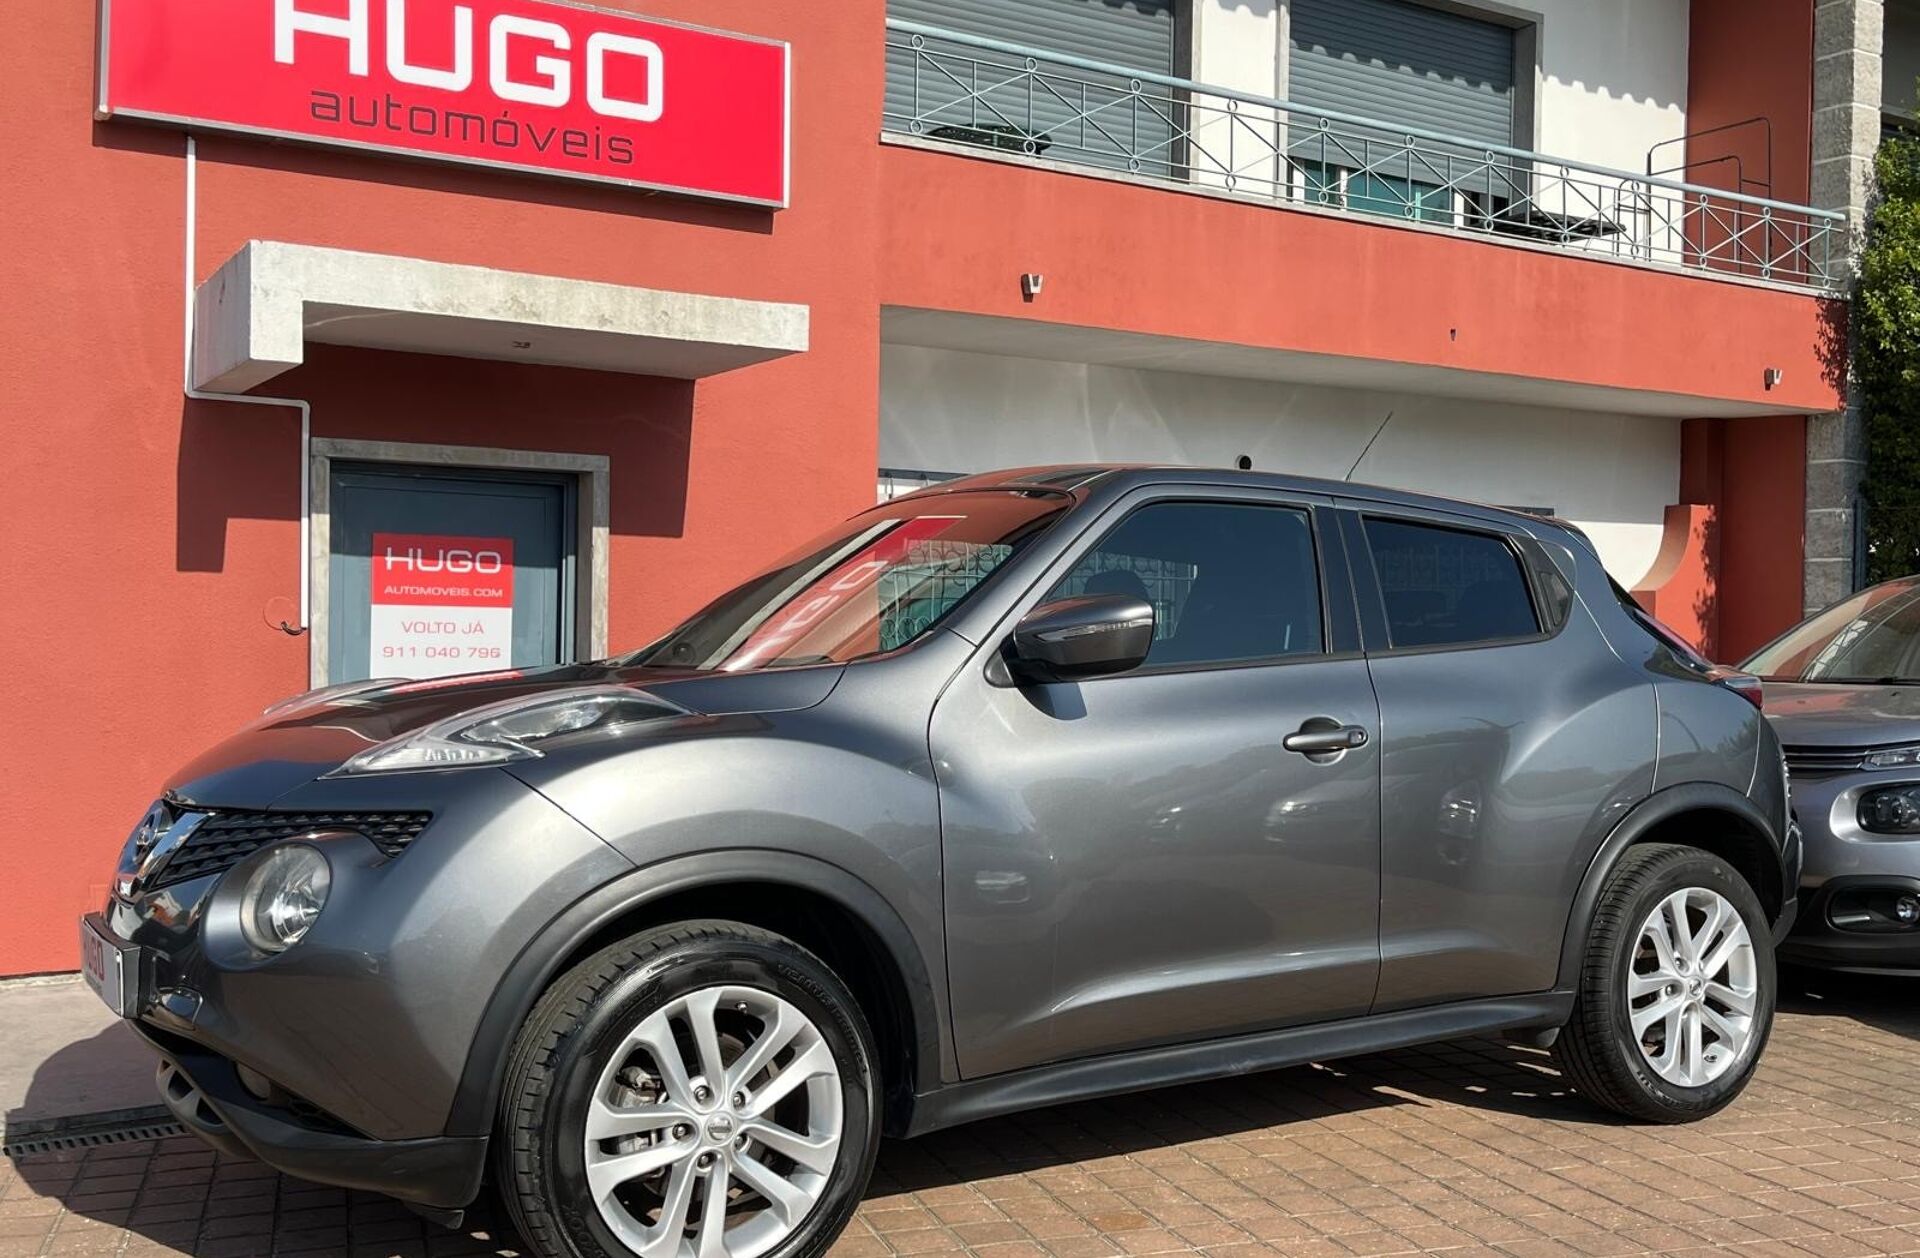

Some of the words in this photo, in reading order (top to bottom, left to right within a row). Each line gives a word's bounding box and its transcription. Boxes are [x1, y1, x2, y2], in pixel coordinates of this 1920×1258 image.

[274, 0, 663, 122] HUGO
[310, 89, 634, 165] automóveis
[385, 547, 501, 574] HUGO
[401, 621, 457, 634] VOLTO
[462, 620, 485, 634] JÁ
[382, 646, 416, 658] 911
[425, 646, 460, 659] 040
